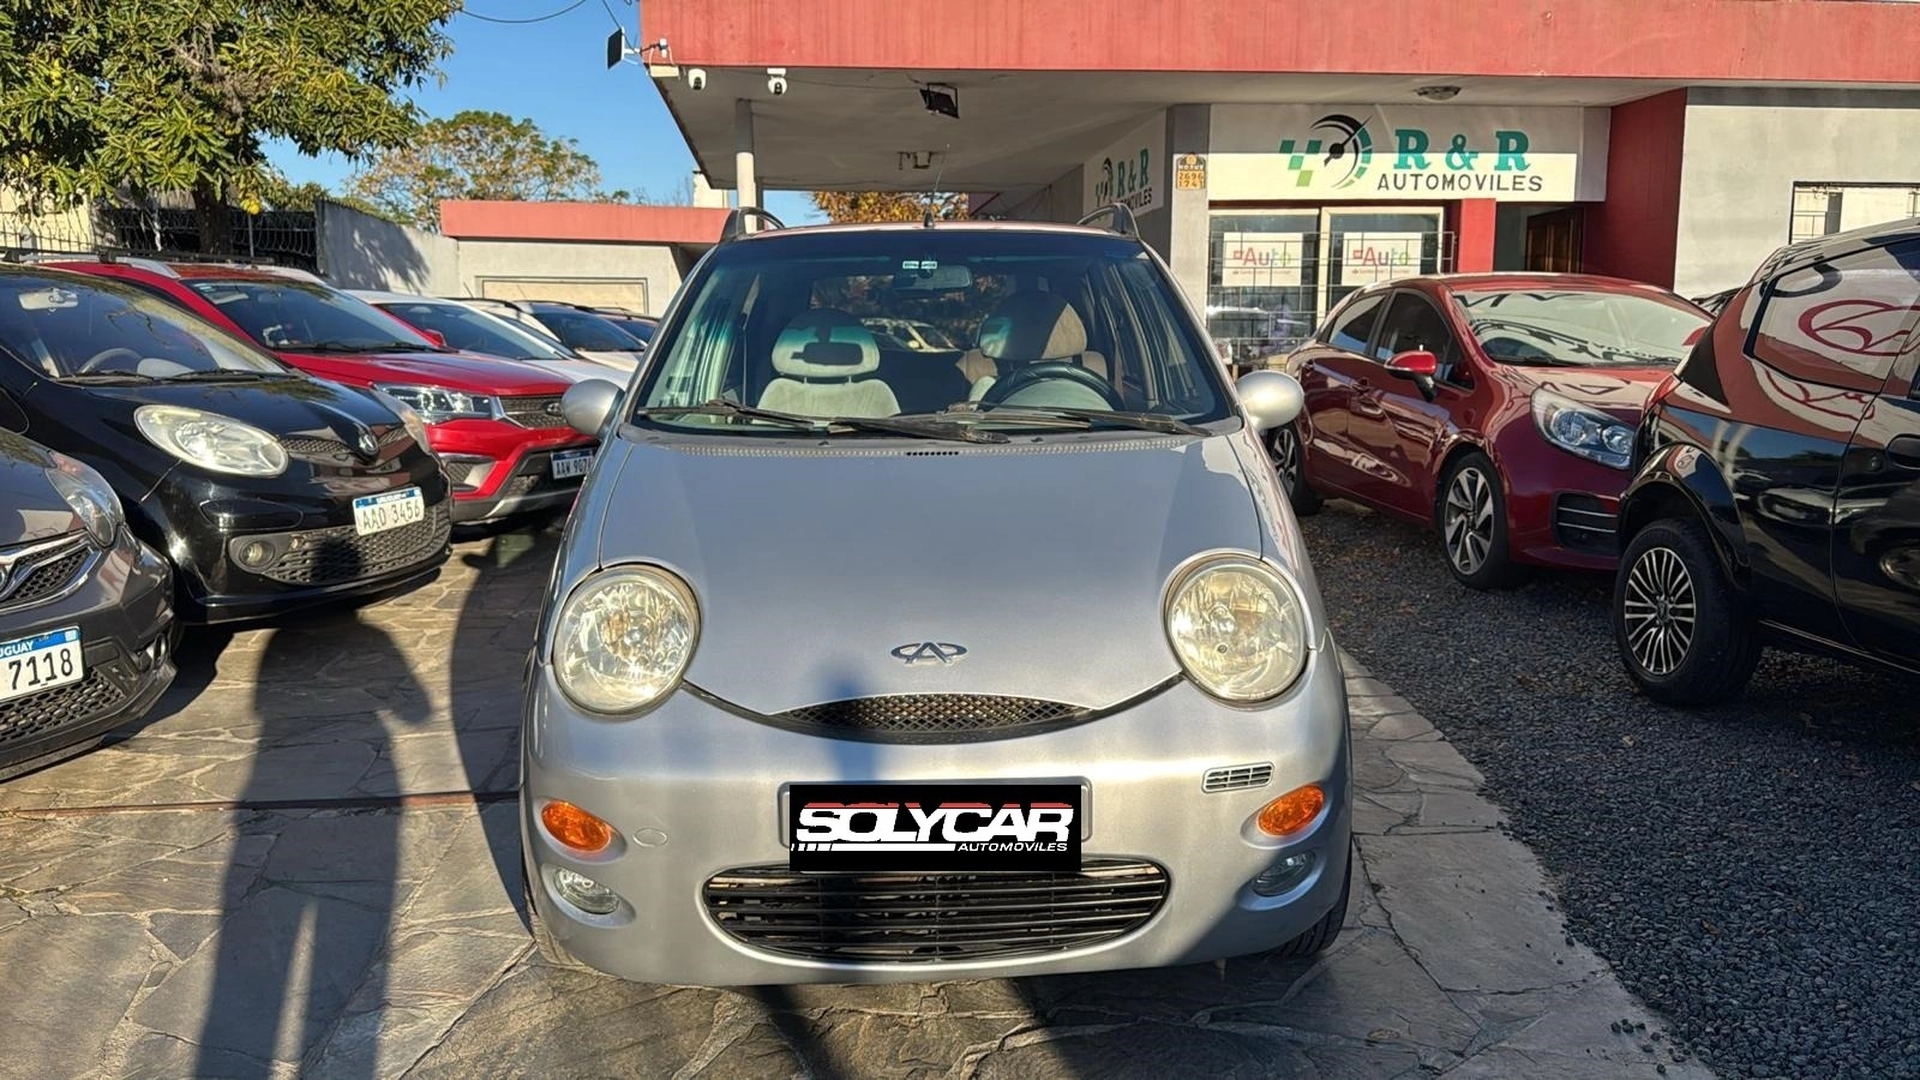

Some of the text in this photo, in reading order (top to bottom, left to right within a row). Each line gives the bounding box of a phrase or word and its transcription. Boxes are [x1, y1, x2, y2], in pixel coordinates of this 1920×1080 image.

[1393, 129, 1530, 171] R & R
[1117, 160, 1126, 198] R
[1140, 148, 1149, 189] R
[1377, 173, 1543, 192] AUTOMOVILES
[1243, 247, 1291, 266] Auto
[1362, 247, 1411, 266] Auto
[9, 648, 73, 690] 7118
